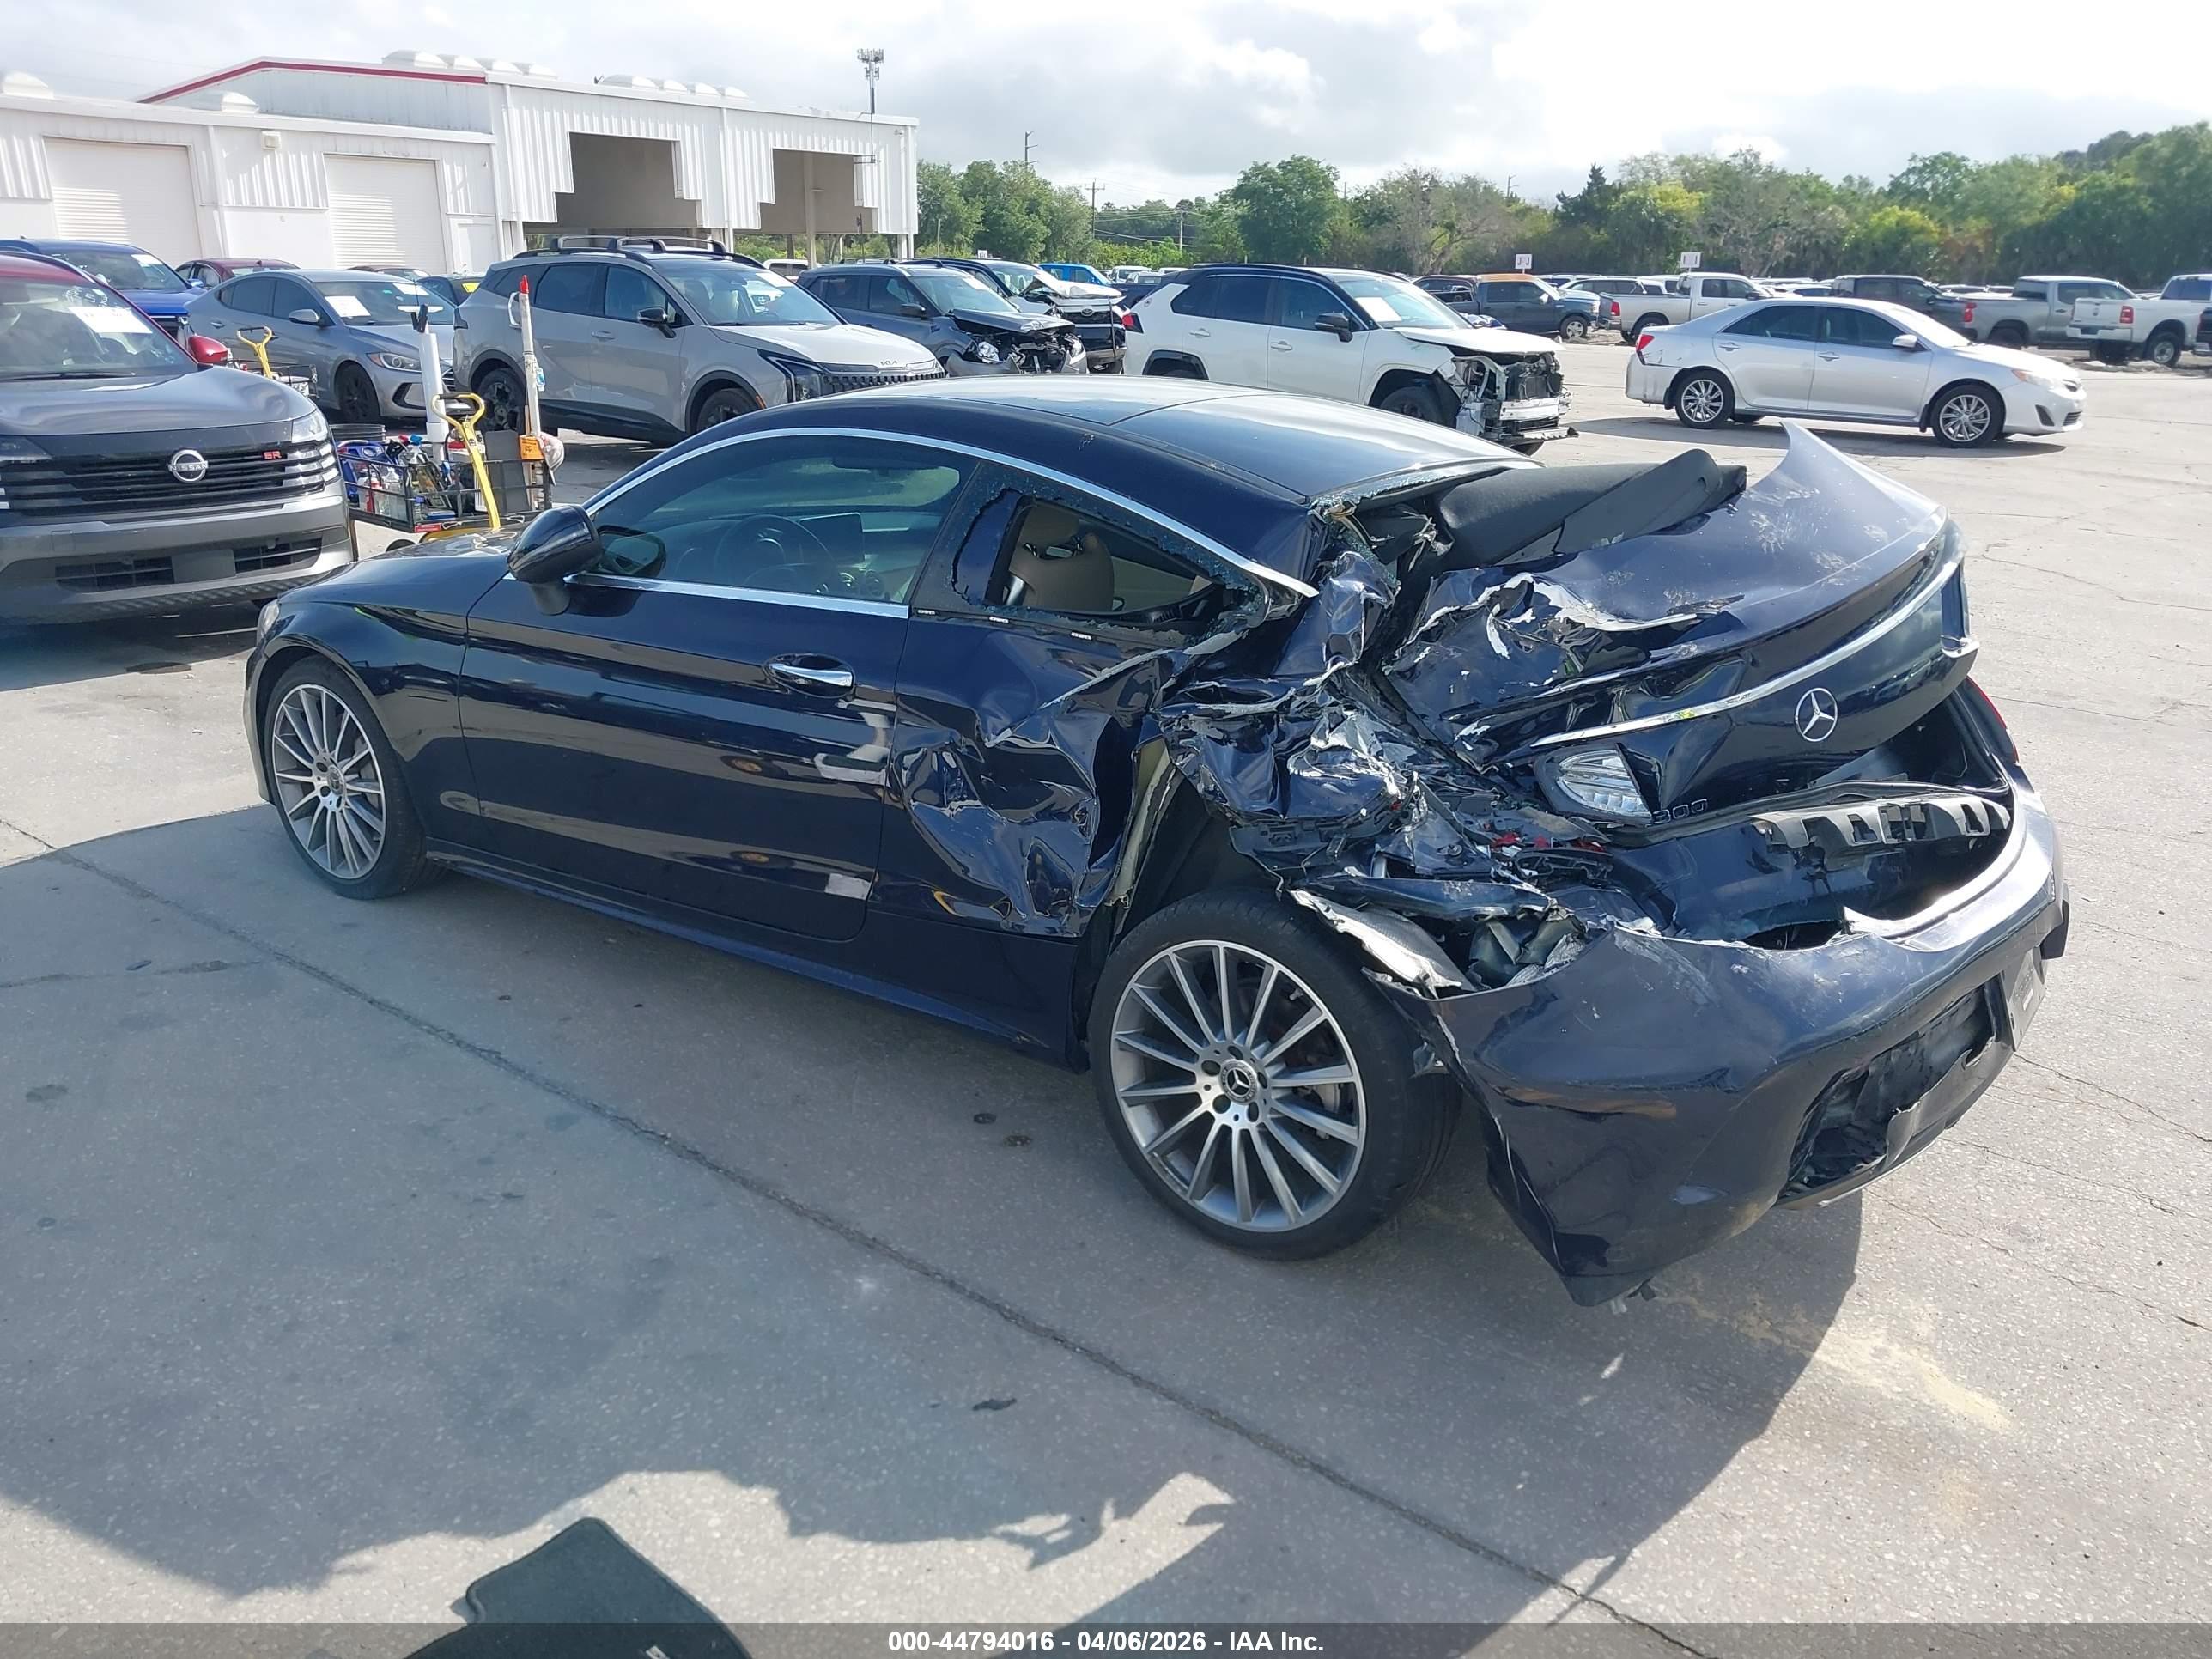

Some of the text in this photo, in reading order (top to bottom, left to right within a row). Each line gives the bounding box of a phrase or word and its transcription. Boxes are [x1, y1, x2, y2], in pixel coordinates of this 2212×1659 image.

[264, 451, 282, 460] SR
[170, 461, 209, 472] NISSAN
[1653, 799, 1708, 824] 300
